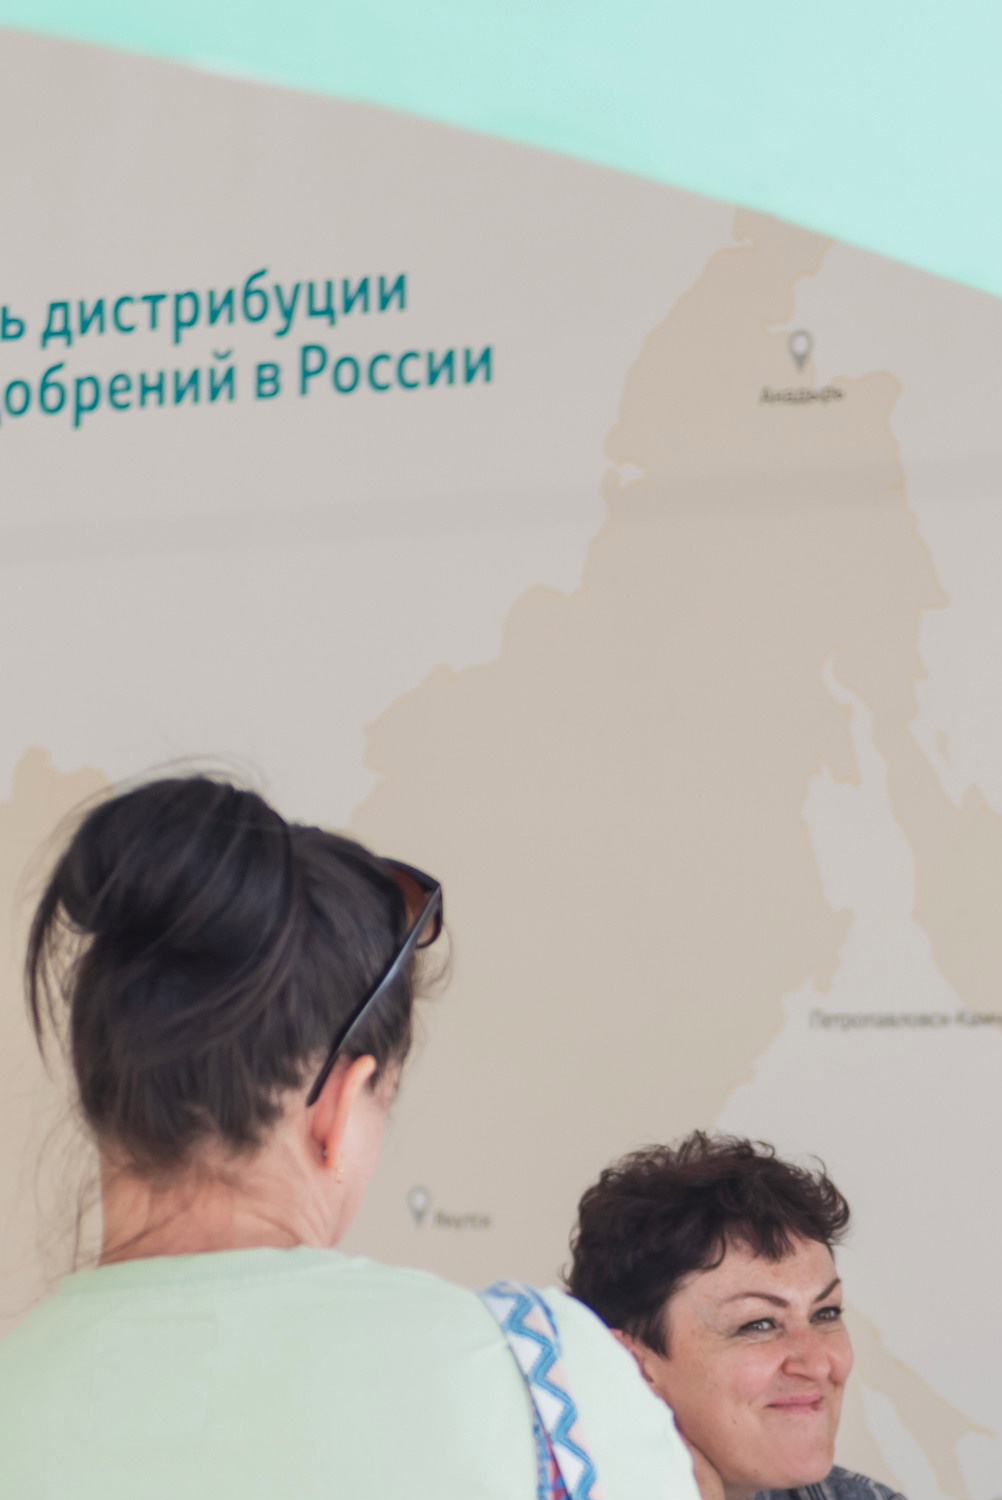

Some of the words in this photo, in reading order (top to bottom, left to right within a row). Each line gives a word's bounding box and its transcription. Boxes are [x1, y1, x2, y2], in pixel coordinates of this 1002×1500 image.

[40, 267, 408, 350] дистрибуции
[0, 349, 236, 430] обрений
[255, 361, 282, 401] в
[299, 343, 494, 397] России
